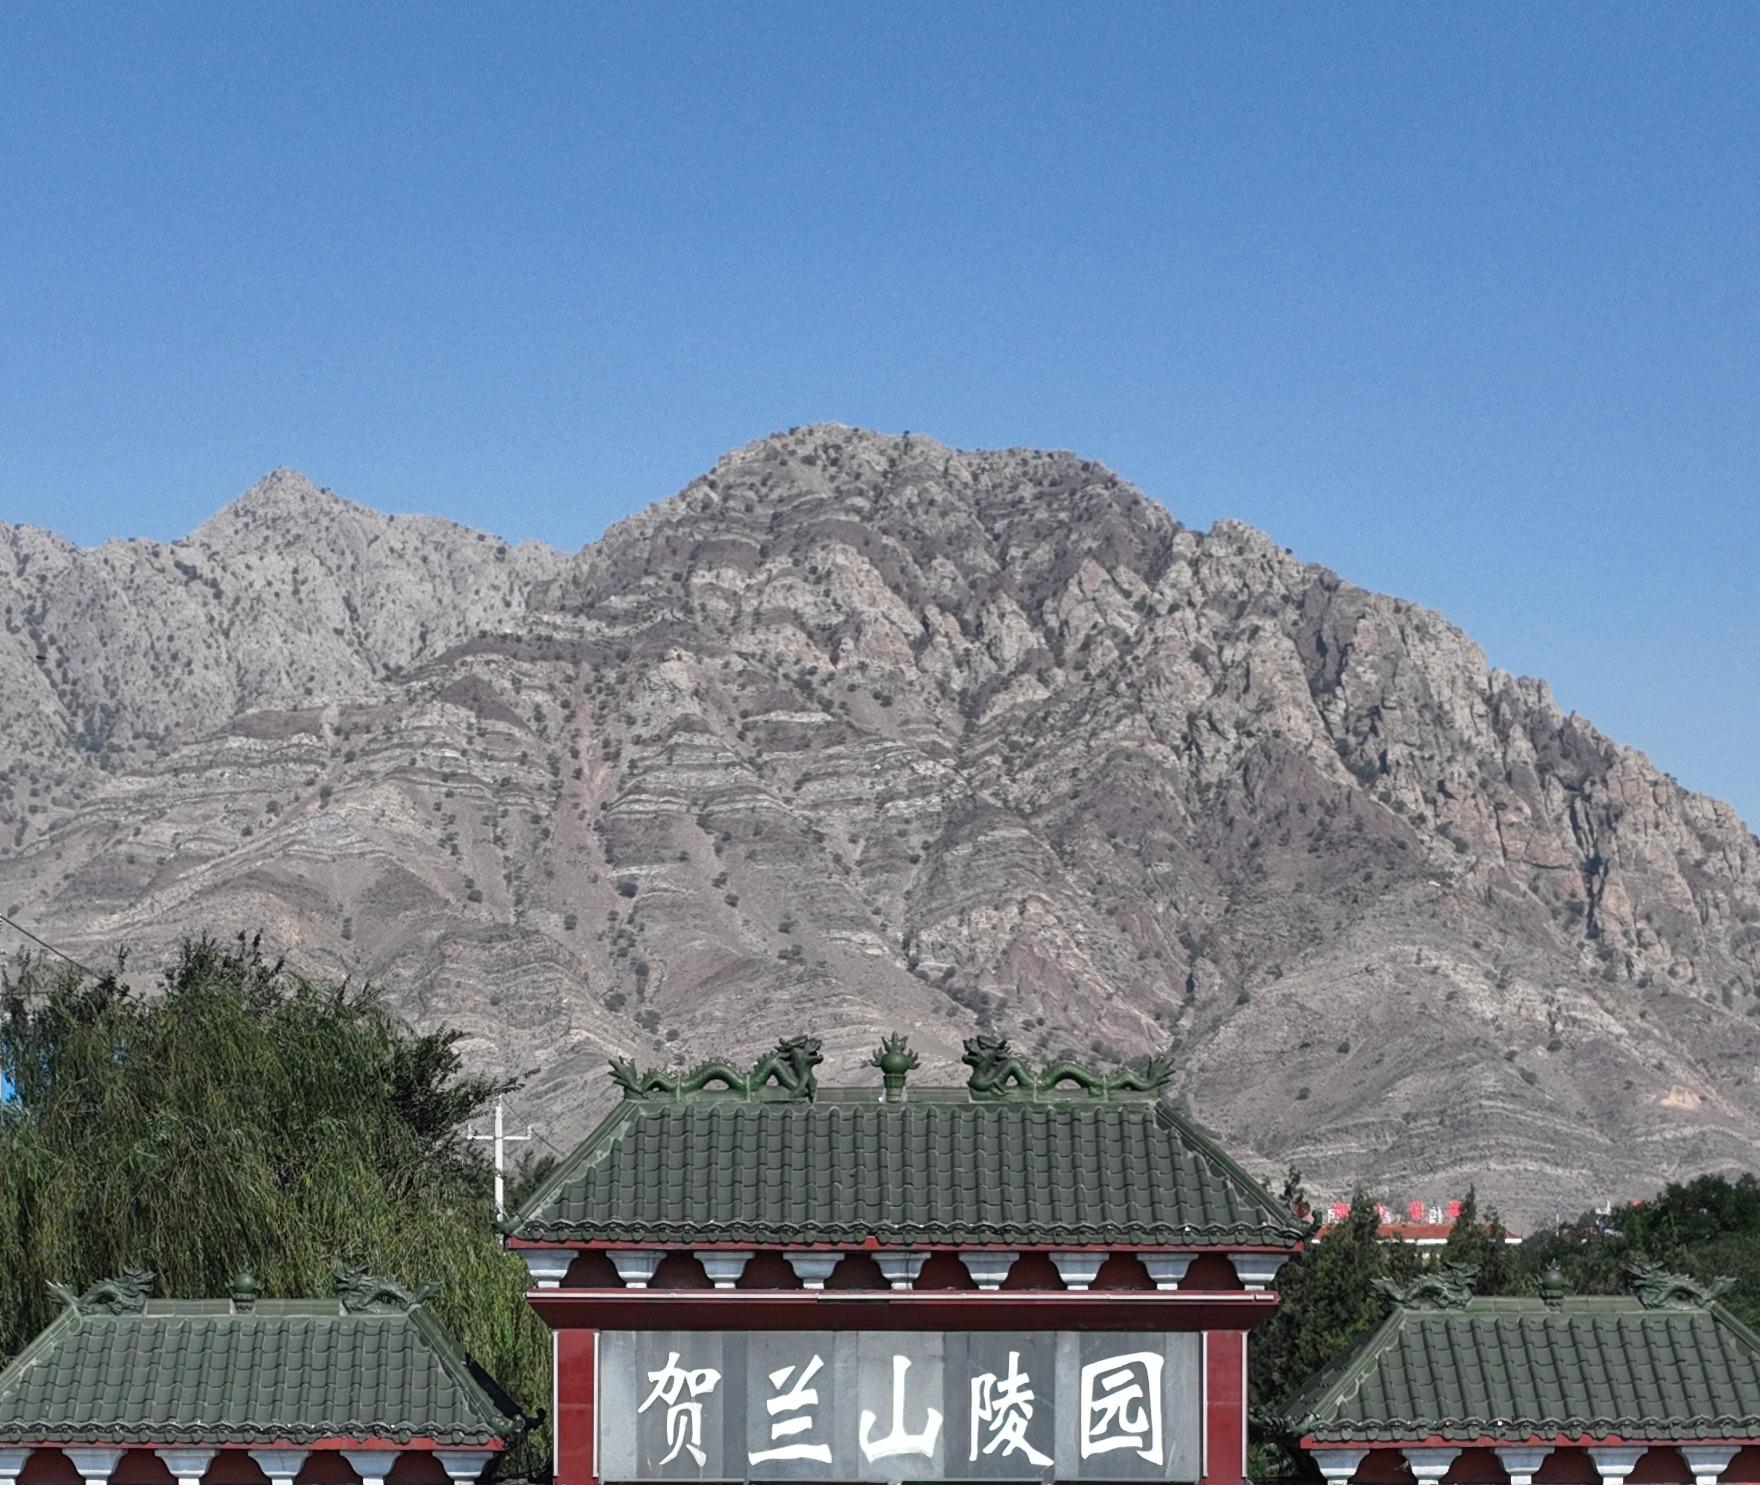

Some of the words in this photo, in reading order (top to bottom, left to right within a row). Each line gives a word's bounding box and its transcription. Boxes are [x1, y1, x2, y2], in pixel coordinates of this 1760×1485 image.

[637, 1350, 1166, 1469] 贺兰山陵园
